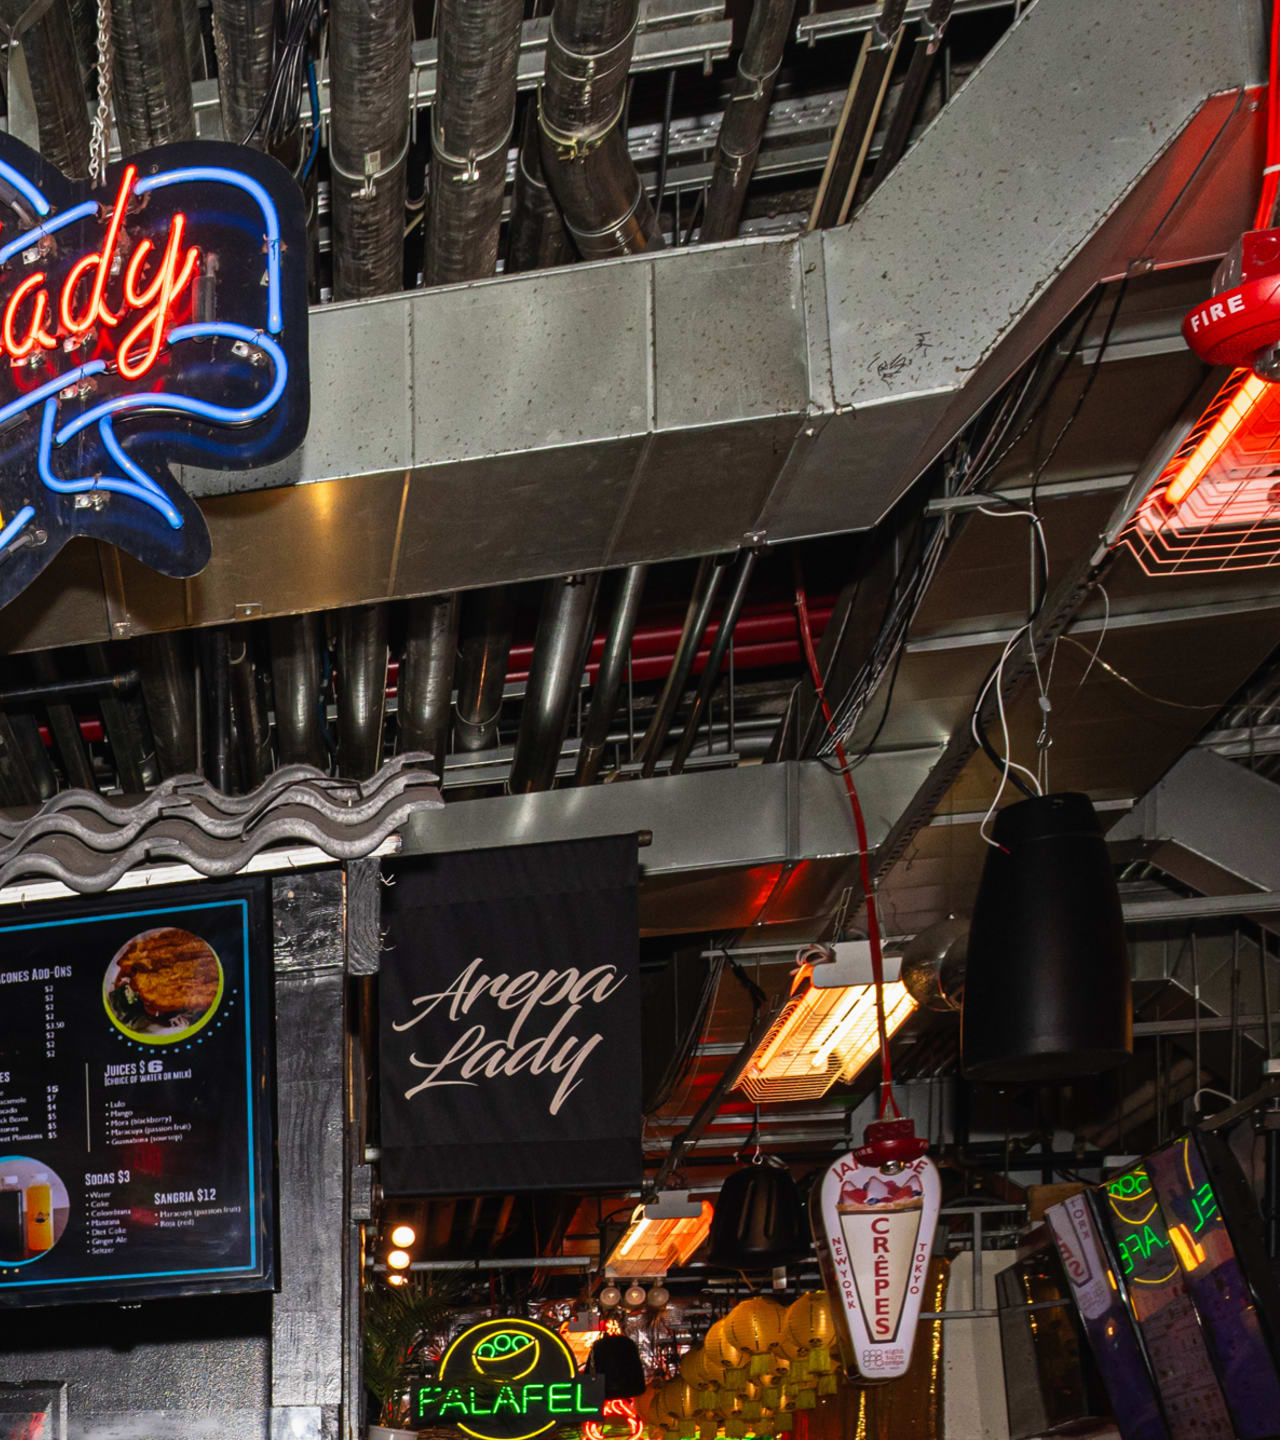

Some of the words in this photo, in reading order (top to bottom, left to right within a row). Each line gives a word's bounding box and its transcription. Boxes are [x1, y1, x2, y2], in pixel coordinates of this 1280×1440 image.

[1190, 294, 1246, 333] FIRE
[31, 965, 72, 981] ADD-ONS
[392, 957, 628, 1050] Arepa
[104, 1063, 137, 1077] JUICES
[147, 1060, 163, 1073] 6
[404, 1004, 604, 1116] Lady
[140, 1073, 162, 1083] WATER
[110, 1110, 133, 1118] Mango
[85, 1172, 115, 1186] SODAS
[117, 1169, 131, 1184] $3
[154, 1191, 195, 1205] SANGRIA
[196, 1187, 217, 1203] $12
[831, 1237, 848, 1266] NEW
[840, 1270, 856, 1309] YORK
[871, 1217, 890, 1335] CRÊPES
[910, 1242, 927, 1294] TOKYO
[418, 1383, 599, 1417] FALAFEL
